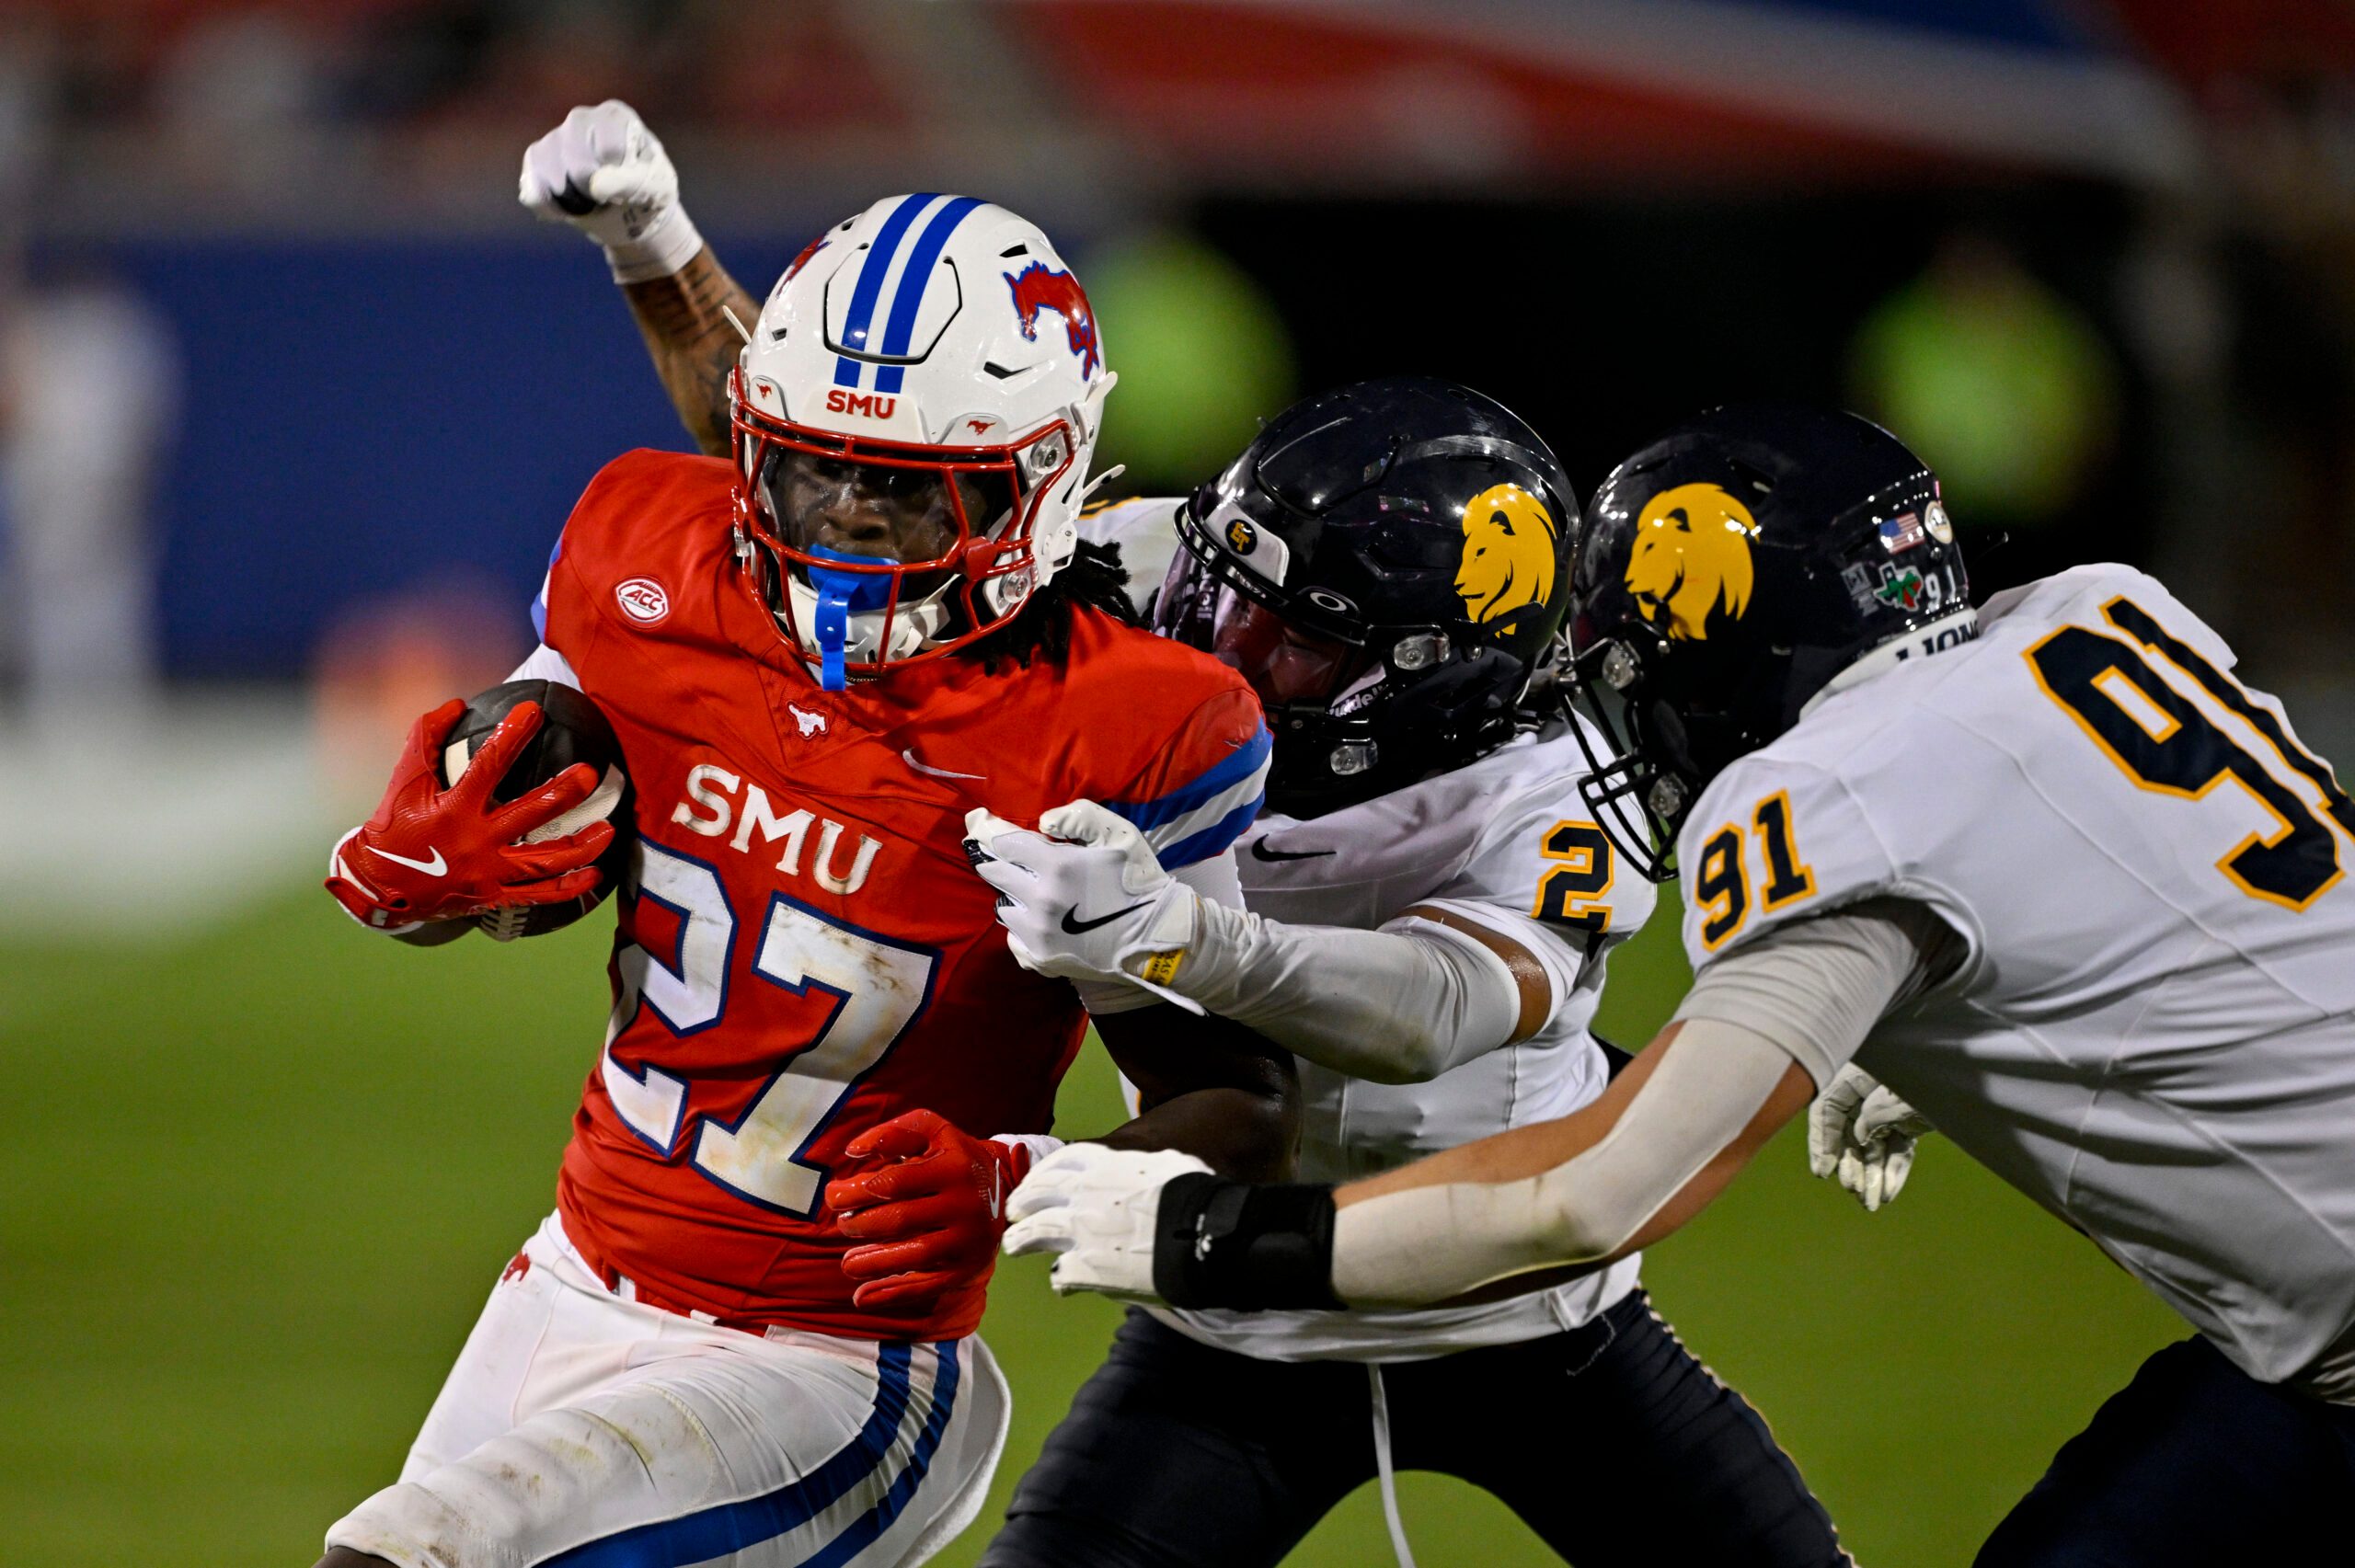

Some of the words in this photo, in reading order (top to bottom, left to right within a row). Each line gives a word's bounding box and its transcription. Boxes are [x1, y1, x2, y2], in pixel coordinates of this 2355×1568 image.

[826, 390, 897, 419] SMU
[625, 589, 662, 611] ACC
[1924, 564, 1959, 613] 91
[2019, 594, 2355, 913] 91
[671, 763, 883, 896] SMU
[1531, 819, 1614, 933] 2
[1694, 788, 1818, 954] 91
[601, 835, 944, 1221] 27
